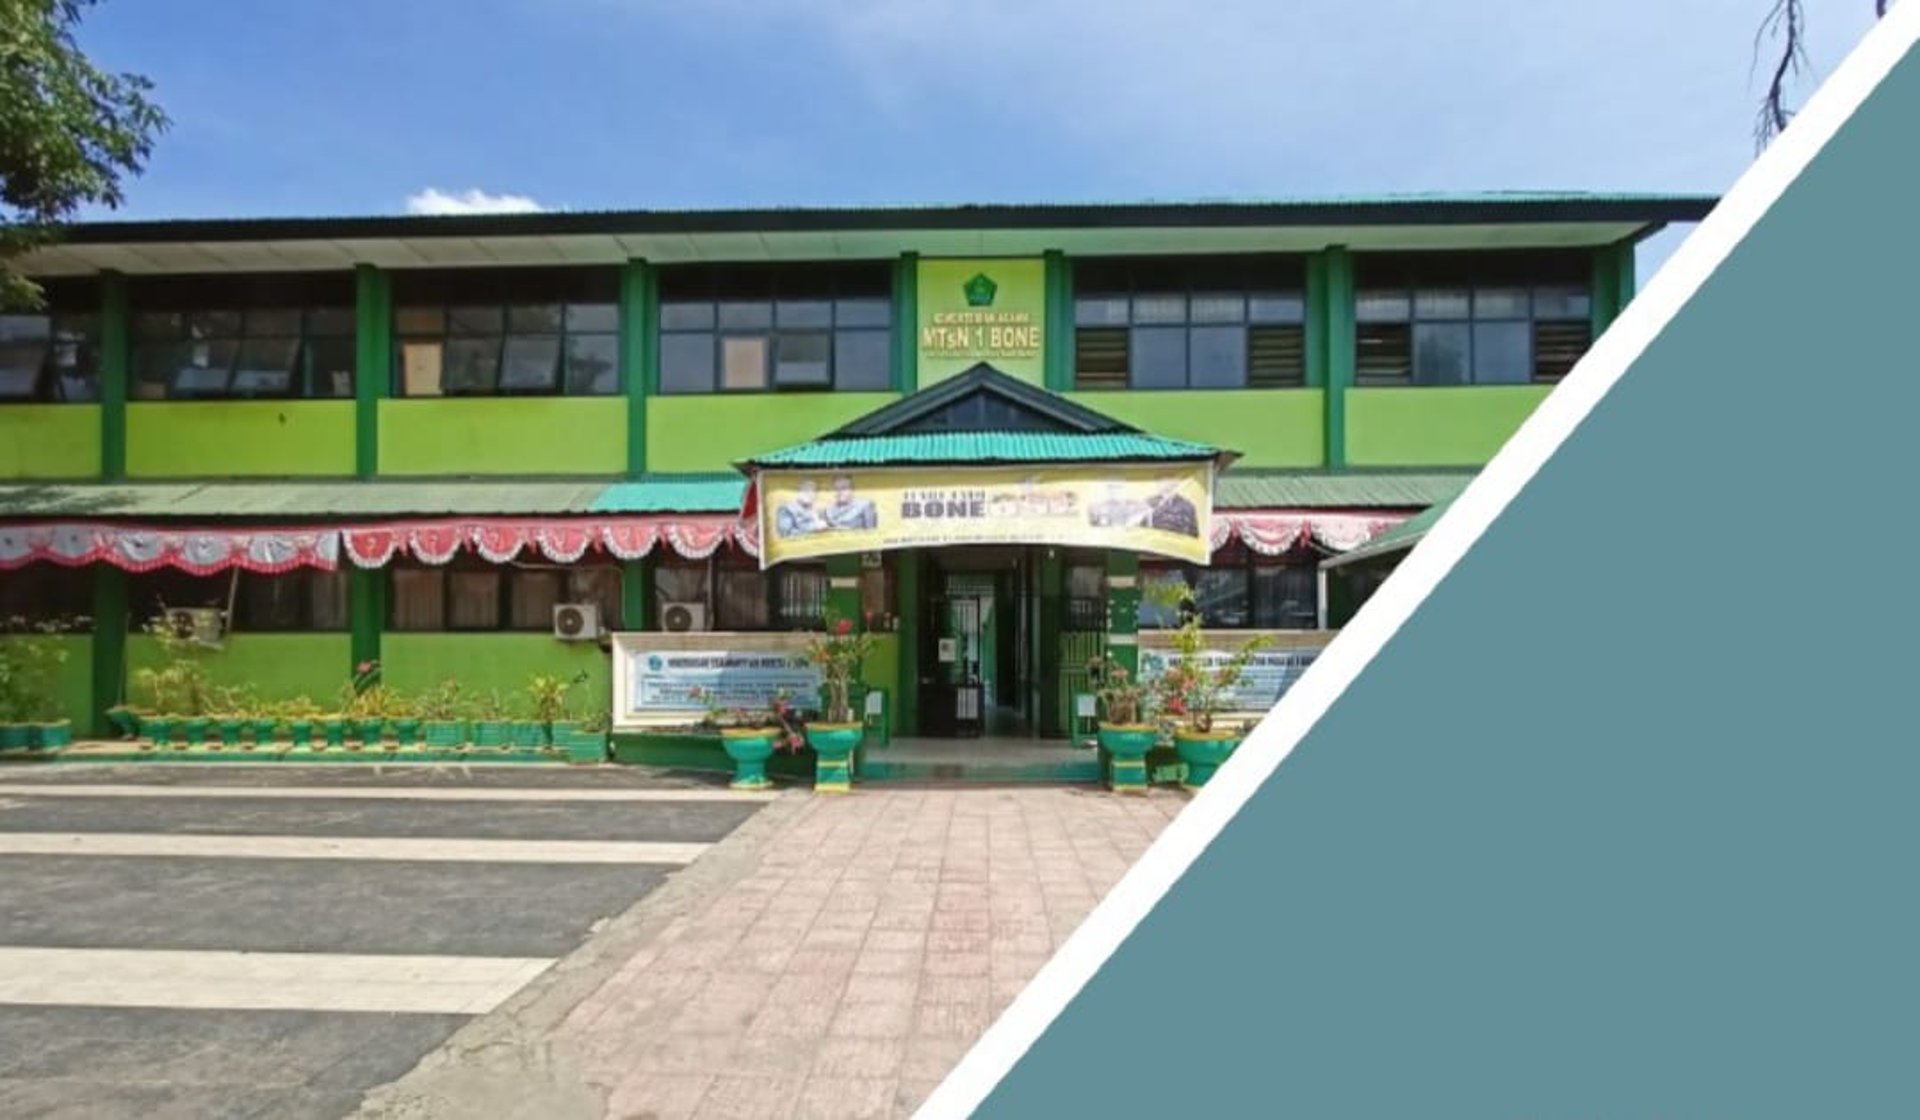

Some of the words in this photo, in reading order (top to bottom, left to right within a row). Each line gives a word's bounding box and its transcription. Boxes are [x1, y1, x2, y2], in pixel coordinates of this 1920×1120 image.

[922, 326, 969, 349] MTsN
[974, 326, 984, 348] 1
[991, 326, 1040, 348] BONE
[902, 501, 985, 518] BONE
